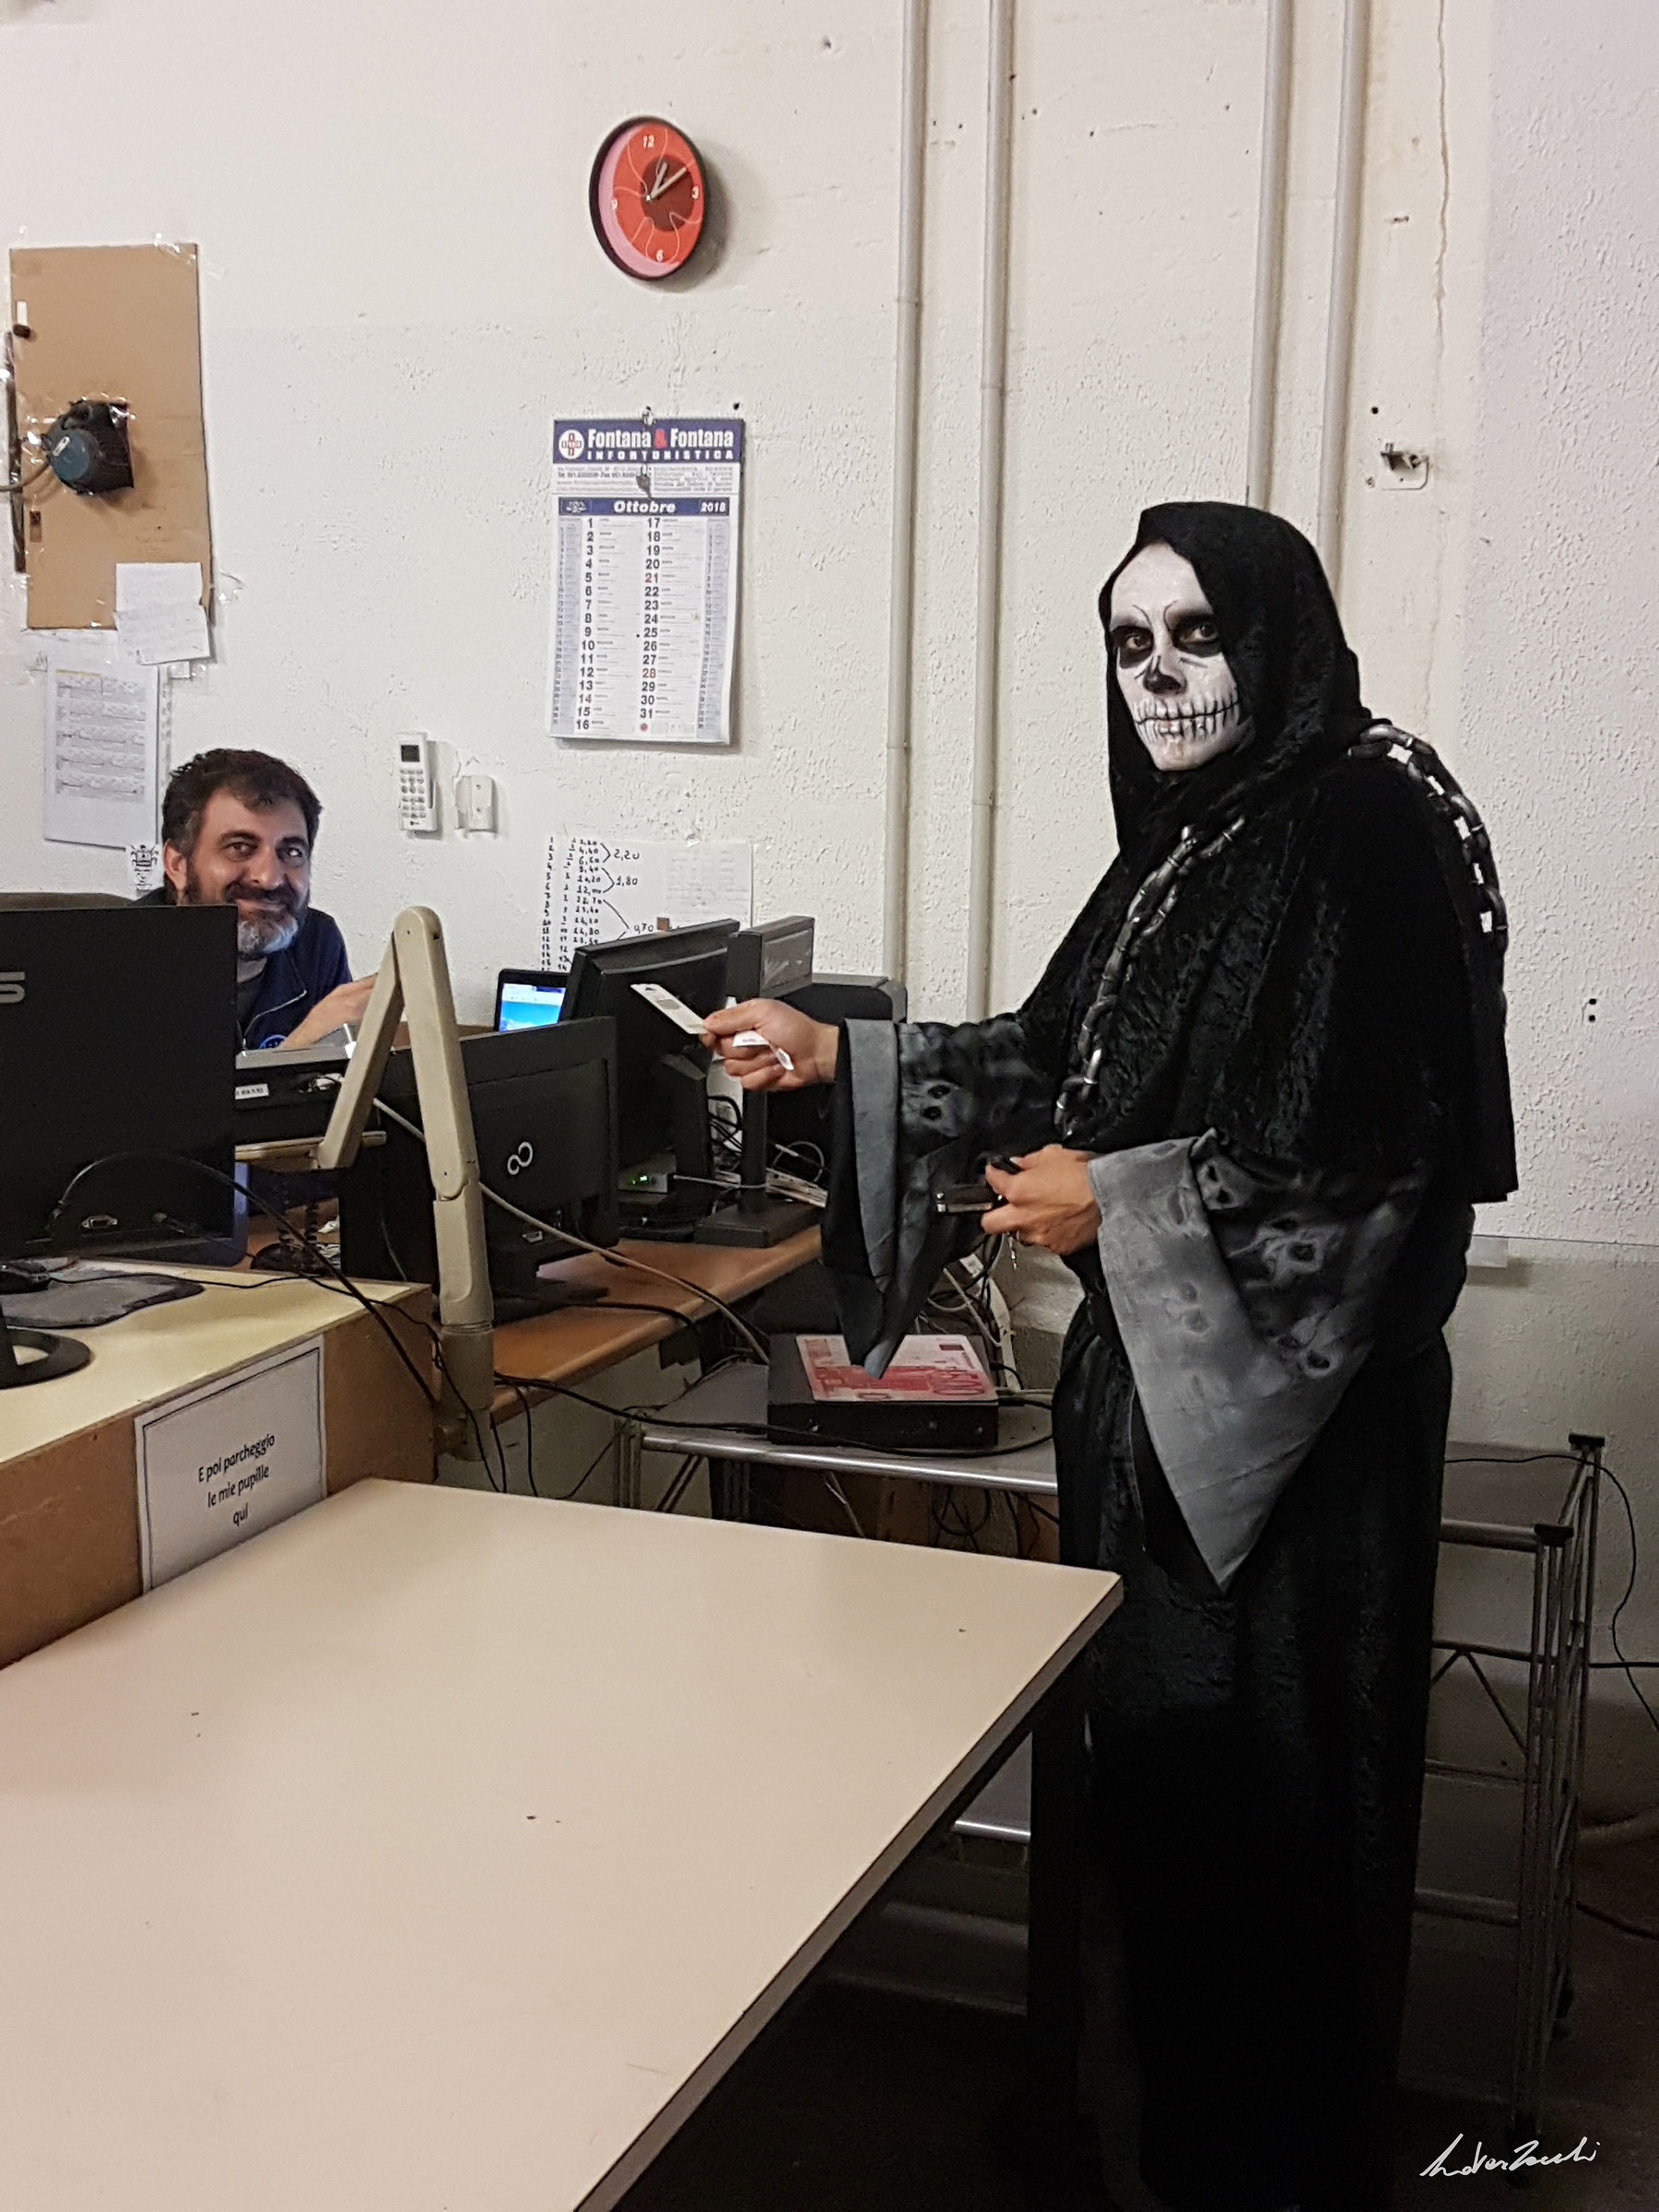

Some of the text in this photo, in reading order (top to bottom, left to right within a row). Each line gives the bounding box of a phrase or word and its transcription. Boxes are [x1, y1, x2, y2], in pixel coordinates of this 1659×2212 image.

[643, 135, 654, 147] 12
[692, 187, 700, 199] 3
[656, 249, 664, 262] 6
[587, 429, 652, 449] Fontana
[670, 429, 734, 449] Fontana
[587, 451, 734, 460] INFORTUNISTICA
[613, 500, 726, 512] Ottobre 2018
[647, 517, 661, 528] 17
[647, 531, 661, 543] 18
[646, 545, 661, 556] 19
[645, 559, 660, 570] 20
[644, 572, 659, 583] 21
[644, 585, 659, 597] 22
[644, 599, 659, 611] 23
[644, 613, 658, 625] 24
[643, 627, 658, 638] 25
[582, 640, 595, 651] 10
[643, 641, 657, 652] 26
[581, 653, 594, 665] 11
[642, 653, 657, 665] 27
[580, 666, 594, 677] 12
[642, 667, 656, 679] 28
[579, 679, 594, 691] 13
[641, 681, 655, 692] 29
[579, 693, 592, 704] 14
[641, 694, 655, 706] 30
[578, 706, 591, 717] 15
[640, 708, 653, 719] 31
[576, 719, 590, 730] 16
[614, 848, 641, 862] 2,20
[198, 1434, 276, 1482] E poi parcheggio
[207, 1465, 269, 1507] le mie pupille
[233, 1503, 249, 1526] qui
